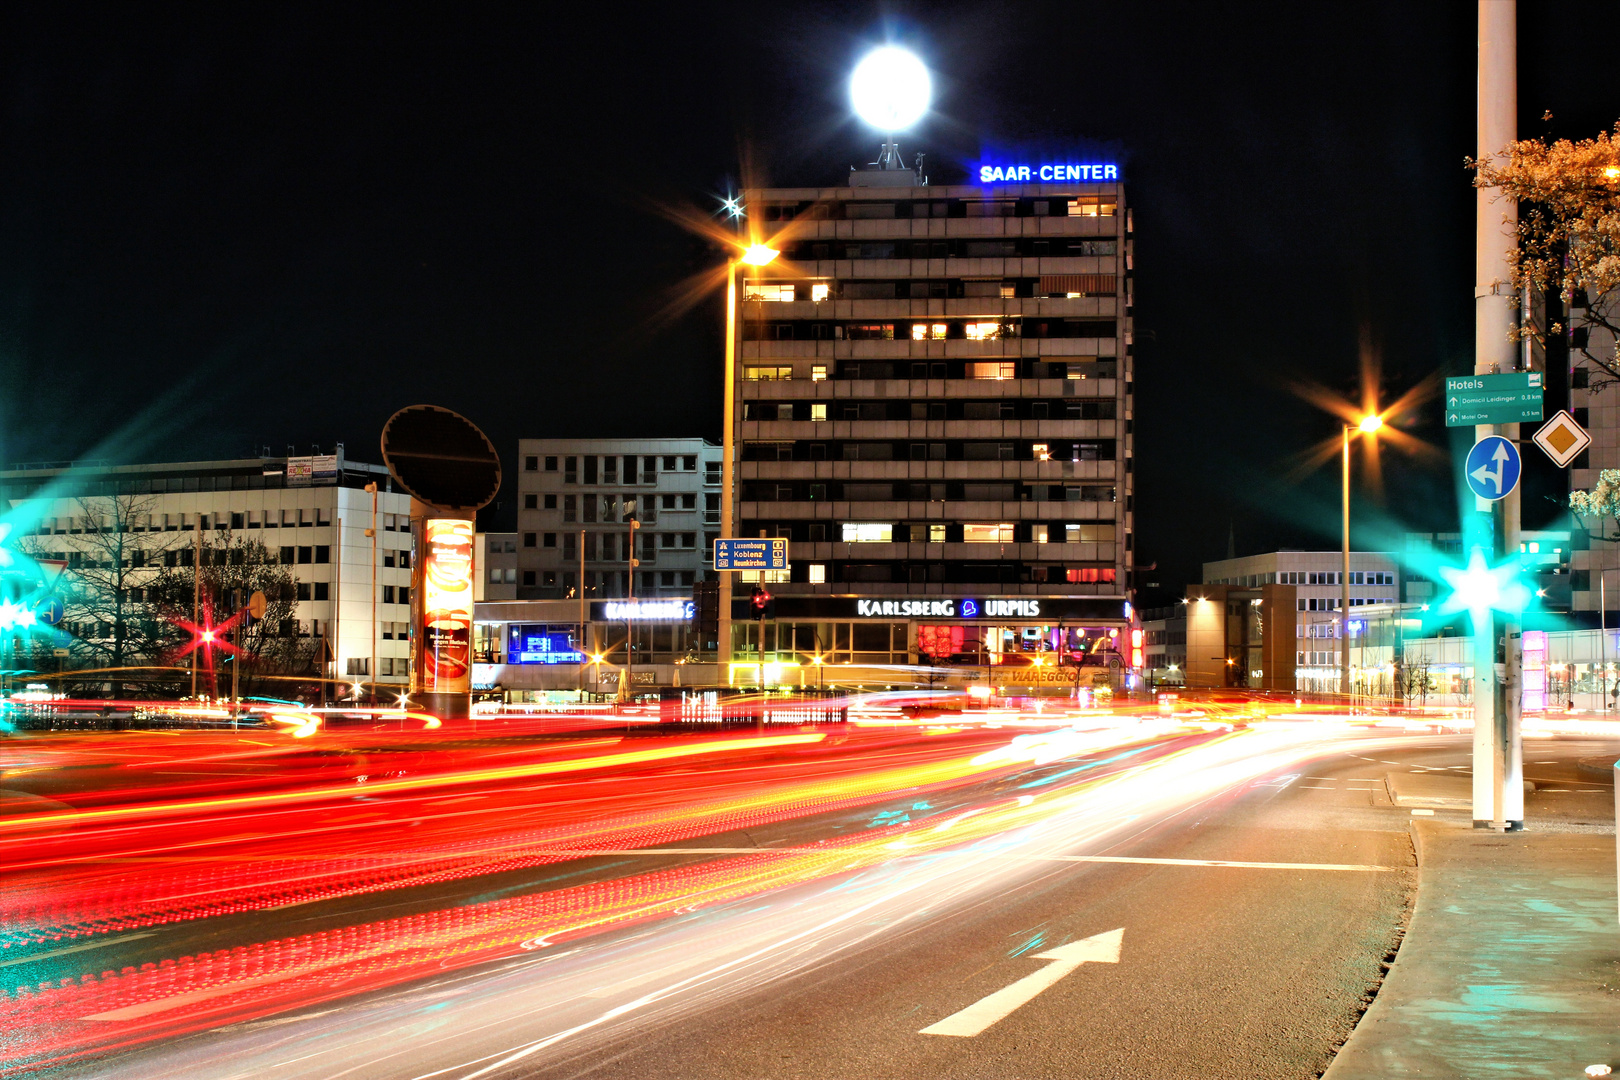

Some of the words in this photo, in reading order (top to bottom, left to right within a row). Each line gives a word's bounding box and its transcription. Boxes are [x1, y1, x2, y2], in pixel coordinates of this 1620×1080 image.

[979, 165, 1117, 182] SAAR-CENTER
[1448, 379, 1484, 390] Hotels
[1486, 395, 1516, 403] Leidinger
[288, 467, 311, 475] REXHA
[733, 542, 767, 551] Luxembourg
[733, 559, 767, 567] Neunkirchen
[857, 600, 955, 617] KARLSBERG
[985, 600, 1040, 616] URPILS
[1012, 671, 1077, 682] VIAREGGIO
